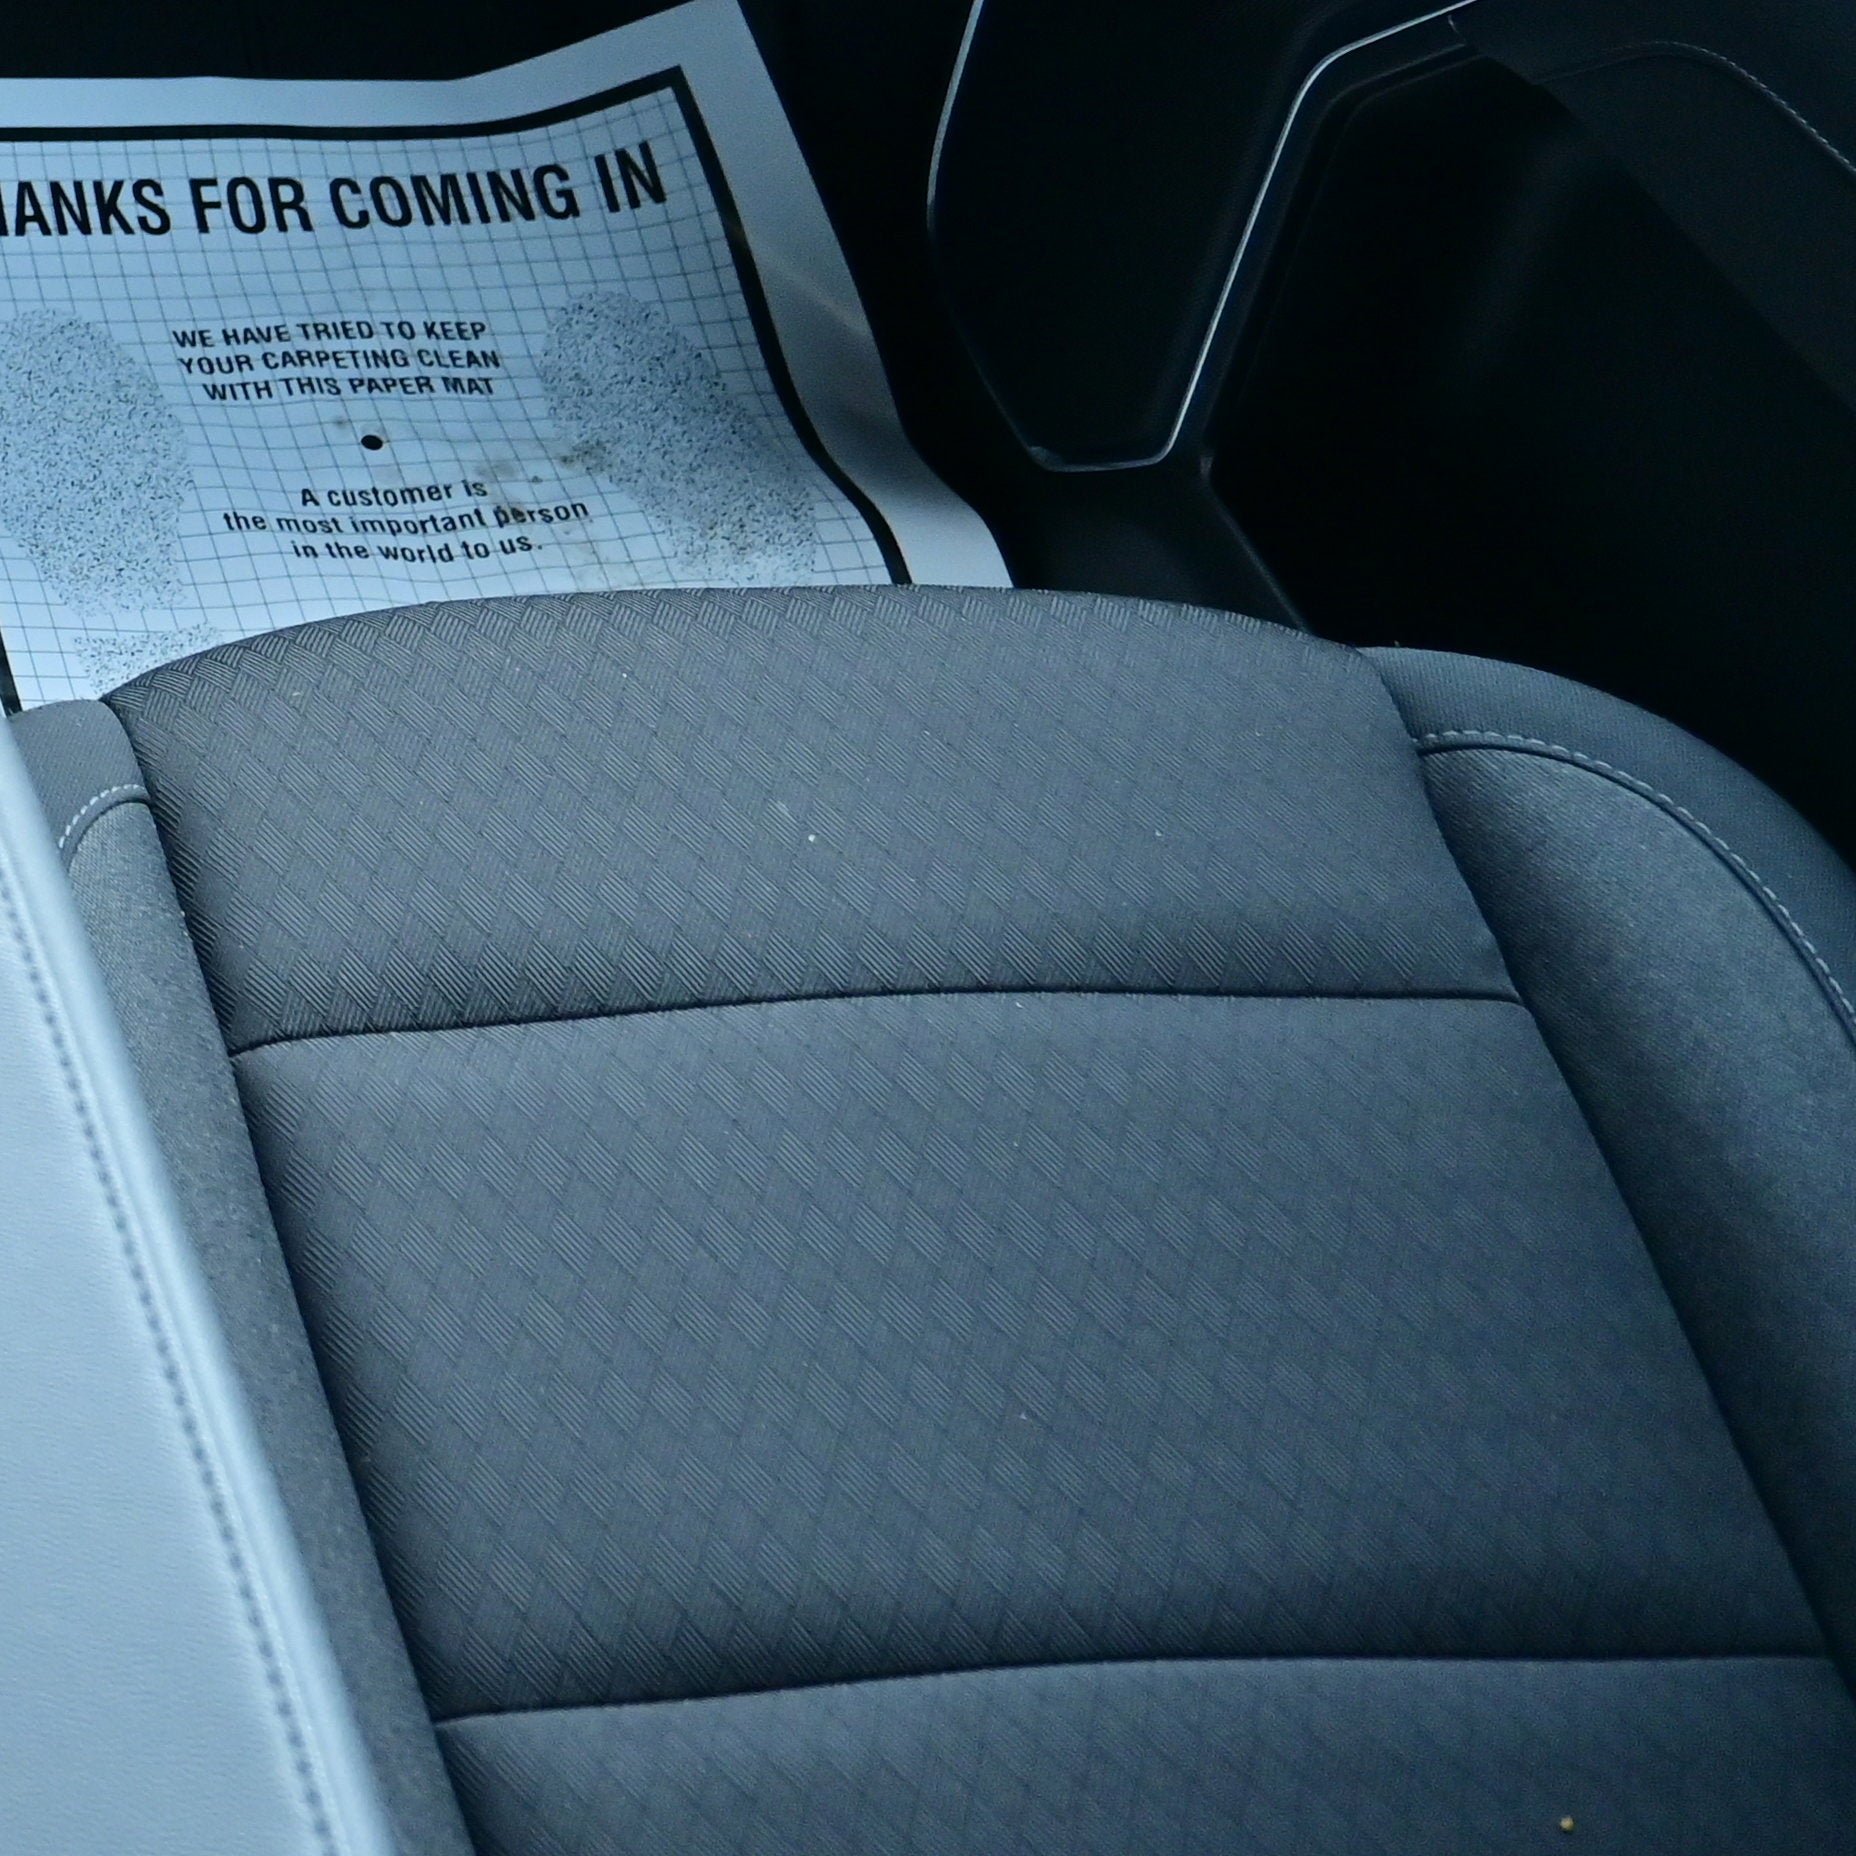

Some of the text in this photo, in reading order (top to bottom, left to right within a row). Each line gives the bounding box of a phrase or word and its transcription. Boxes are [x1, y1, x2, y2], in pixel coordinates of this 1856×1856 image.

[190, 174, 314, 236] FOR
[328, 162, 582, 231] COMING
[593, 141, 668, 214] IN
[172, 321, 487, 349] WE HAVE TRIED TO KEEP
[178, 349, 501, 376] YOUR CARPETING CLEAN
[202, 375, 497, 402] WITH THIS PAPER MAT
[300, 478, 489, 508] A customer is
[222, 499, 590, 537] the most important person
[290, 535, 543, 564] in the world to us.
